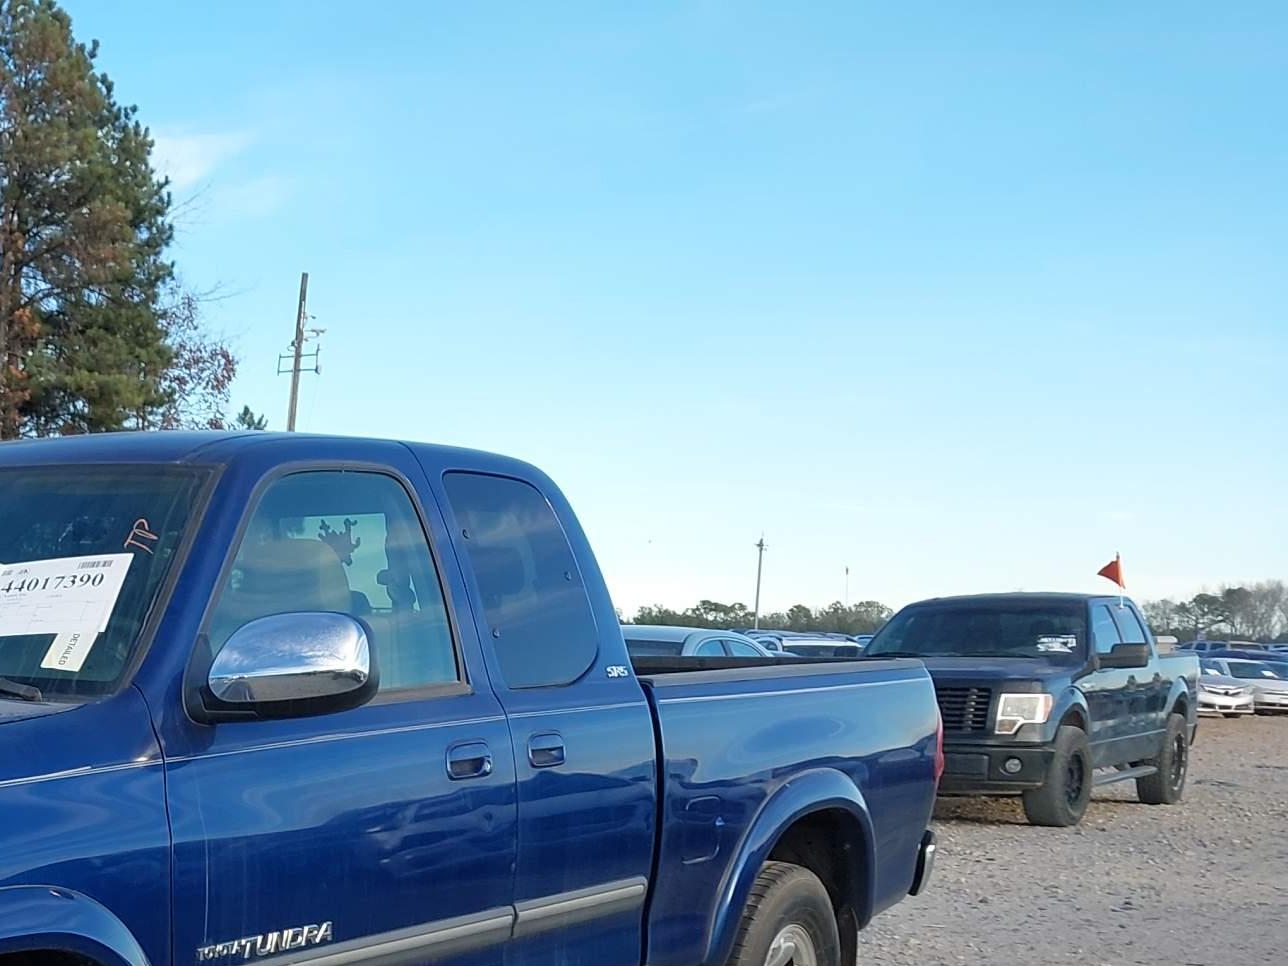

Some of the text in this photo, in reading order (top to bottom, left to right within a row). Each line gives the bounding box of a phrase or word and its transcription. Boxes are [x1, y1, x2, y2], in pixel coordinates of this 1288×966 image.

[1, 573, 105, 593] 44017390
[59, 633, 80, 665] DETAILED
[241, 921, 333, 958] TUNDRA
